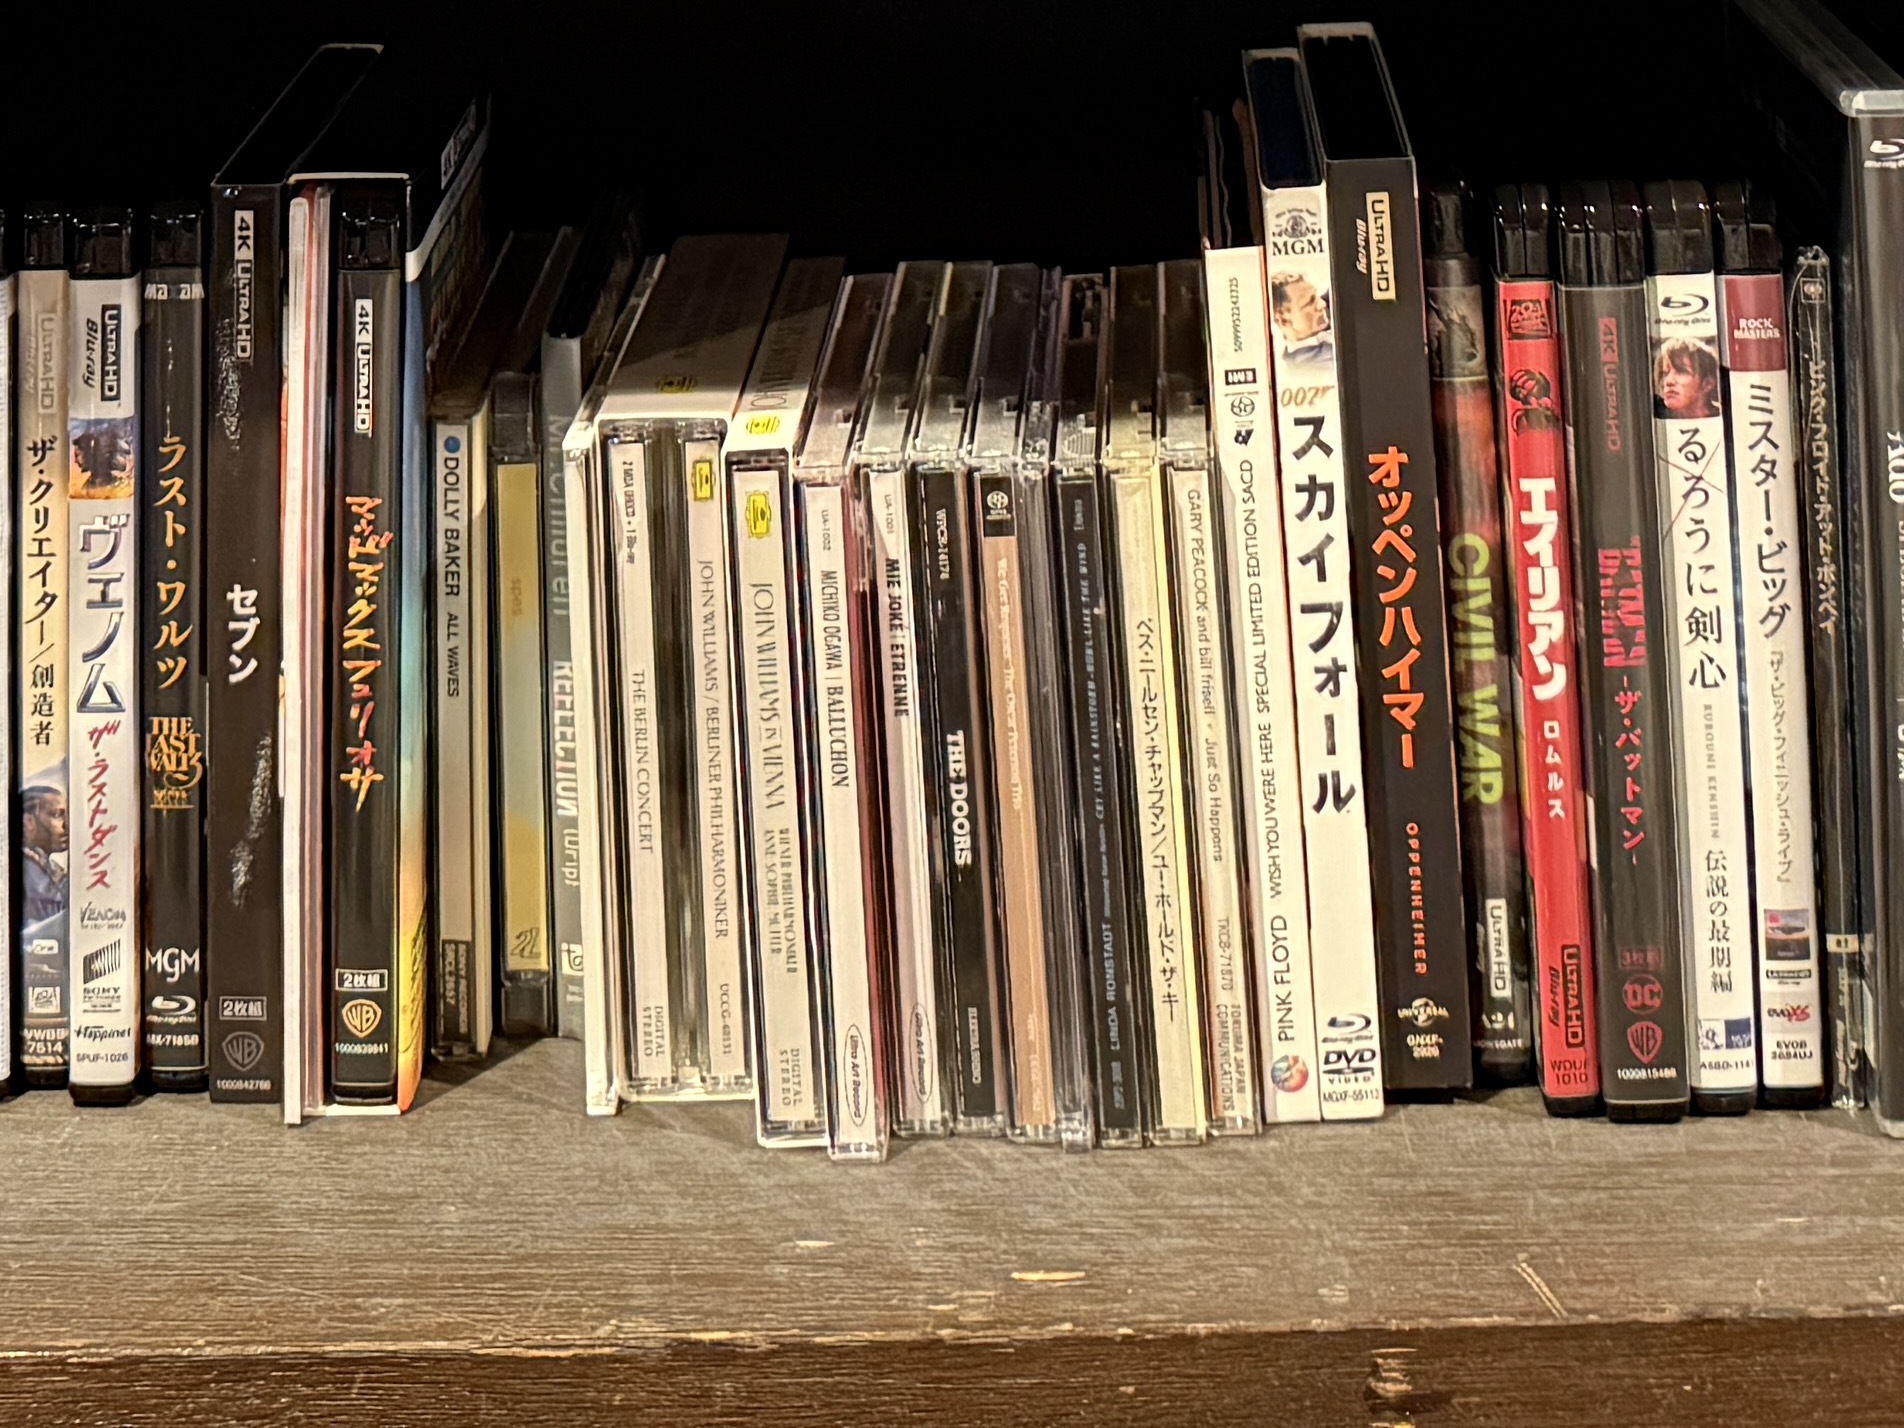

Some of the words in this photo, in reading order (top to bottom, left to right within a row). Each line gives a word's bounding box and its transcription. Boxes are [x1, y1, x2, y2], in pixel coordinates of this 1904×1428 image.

[1739, 317, 1774, 330] ROCK
[1239, 459, 1256, 505] SACD
[1746, 383, 1796, 640] ミスター・ビッグ
[1243, 507, 1263, 579] EDITION
[1677, 426, 1729, 692] るろうに剣心
[1249, 590, 1268, 648] LIMITED
[1291, 415, 1359, 816] スカイフォール
[1367, 445, 1428, 769] オッペンハイマー
[1448, 531, 1498, 668] CIVIL
[1518, 476, 1570, 702] エイリアン
[224, 583, 261, 687] セブン
[1253, 649, 1272, 715] SPECIAL
[1257, 721, 1274, 765] HERE
[1458, 683, 1505, 806] WAR
[1542, 720, 1568, 820] ロムルス
[1268, 861, 1283, 899] WISH
[1405, 822, 1429, 976] OPPENHEIMER
[144, 945, 201, 983] MGM
[1269, 914, 1290, 987] FLOYD
[1276, 990, 1296, 1043] PINK
